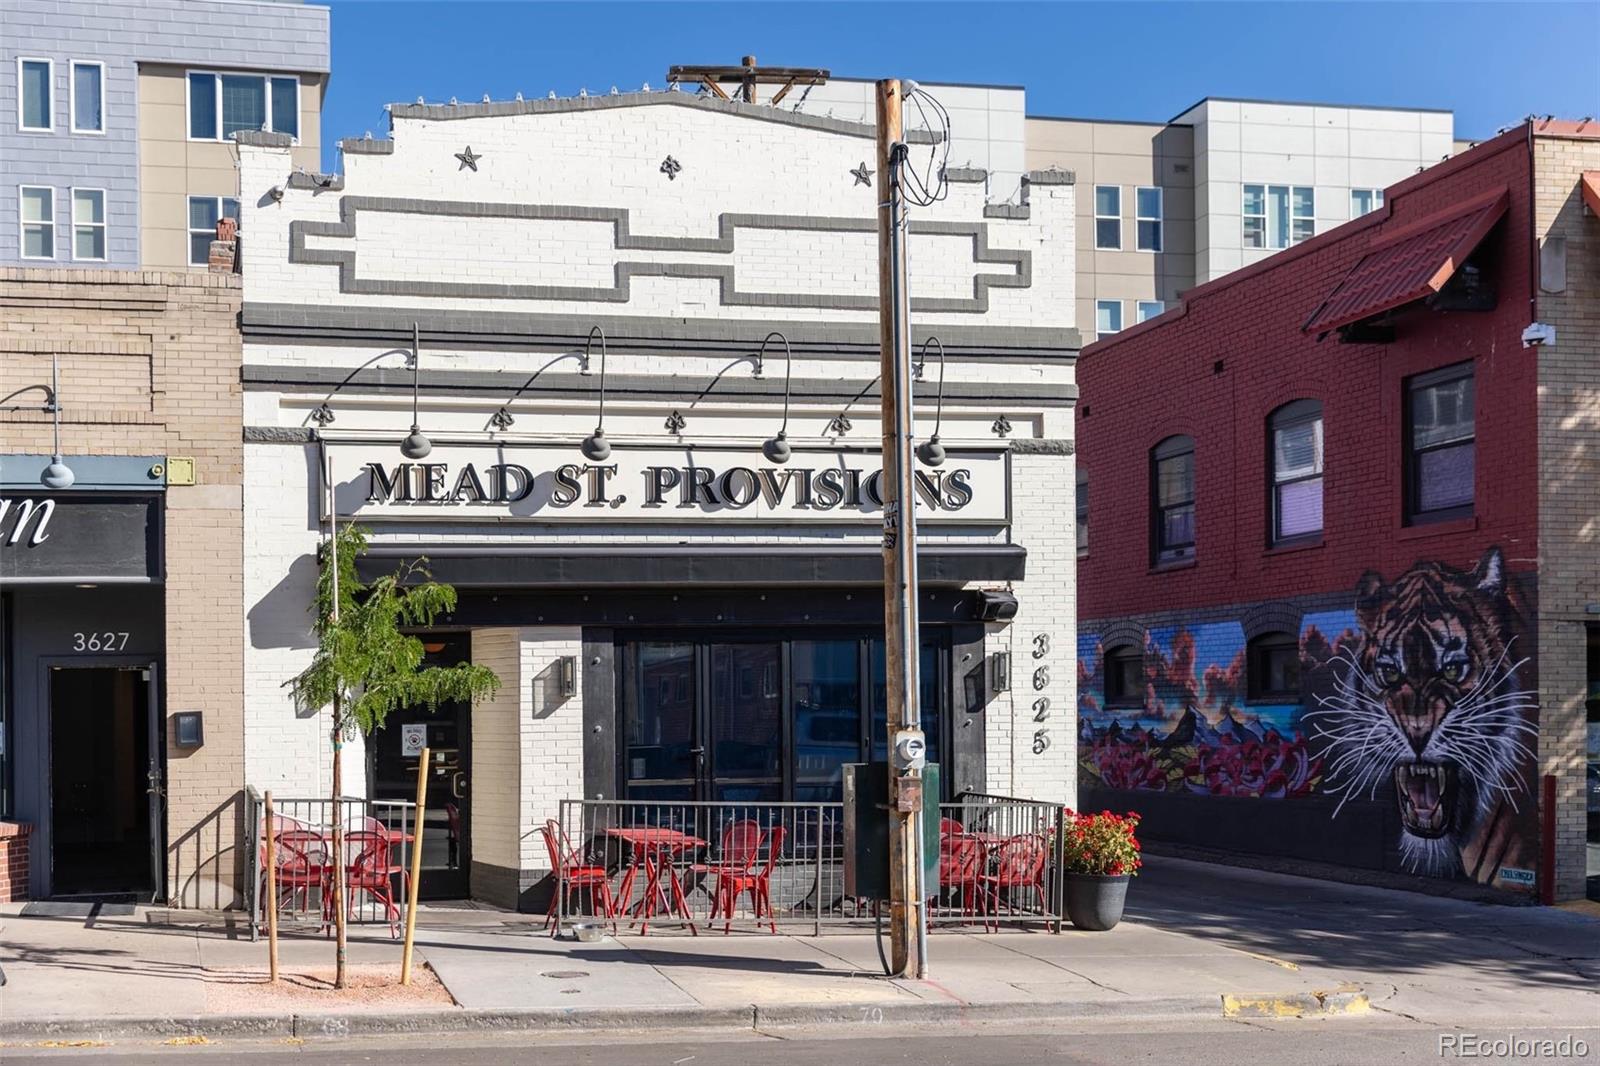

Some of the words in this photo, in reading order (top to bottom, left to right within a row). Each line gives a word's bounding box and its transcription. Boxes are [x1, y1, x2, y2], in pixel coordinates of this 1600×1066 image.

[366, 462, 535, 502] MEAD
[553, 463, 627, 504] ST.
[73, 632, 130, 651] 3627
[1032, 633, 1051, 755] 3625
